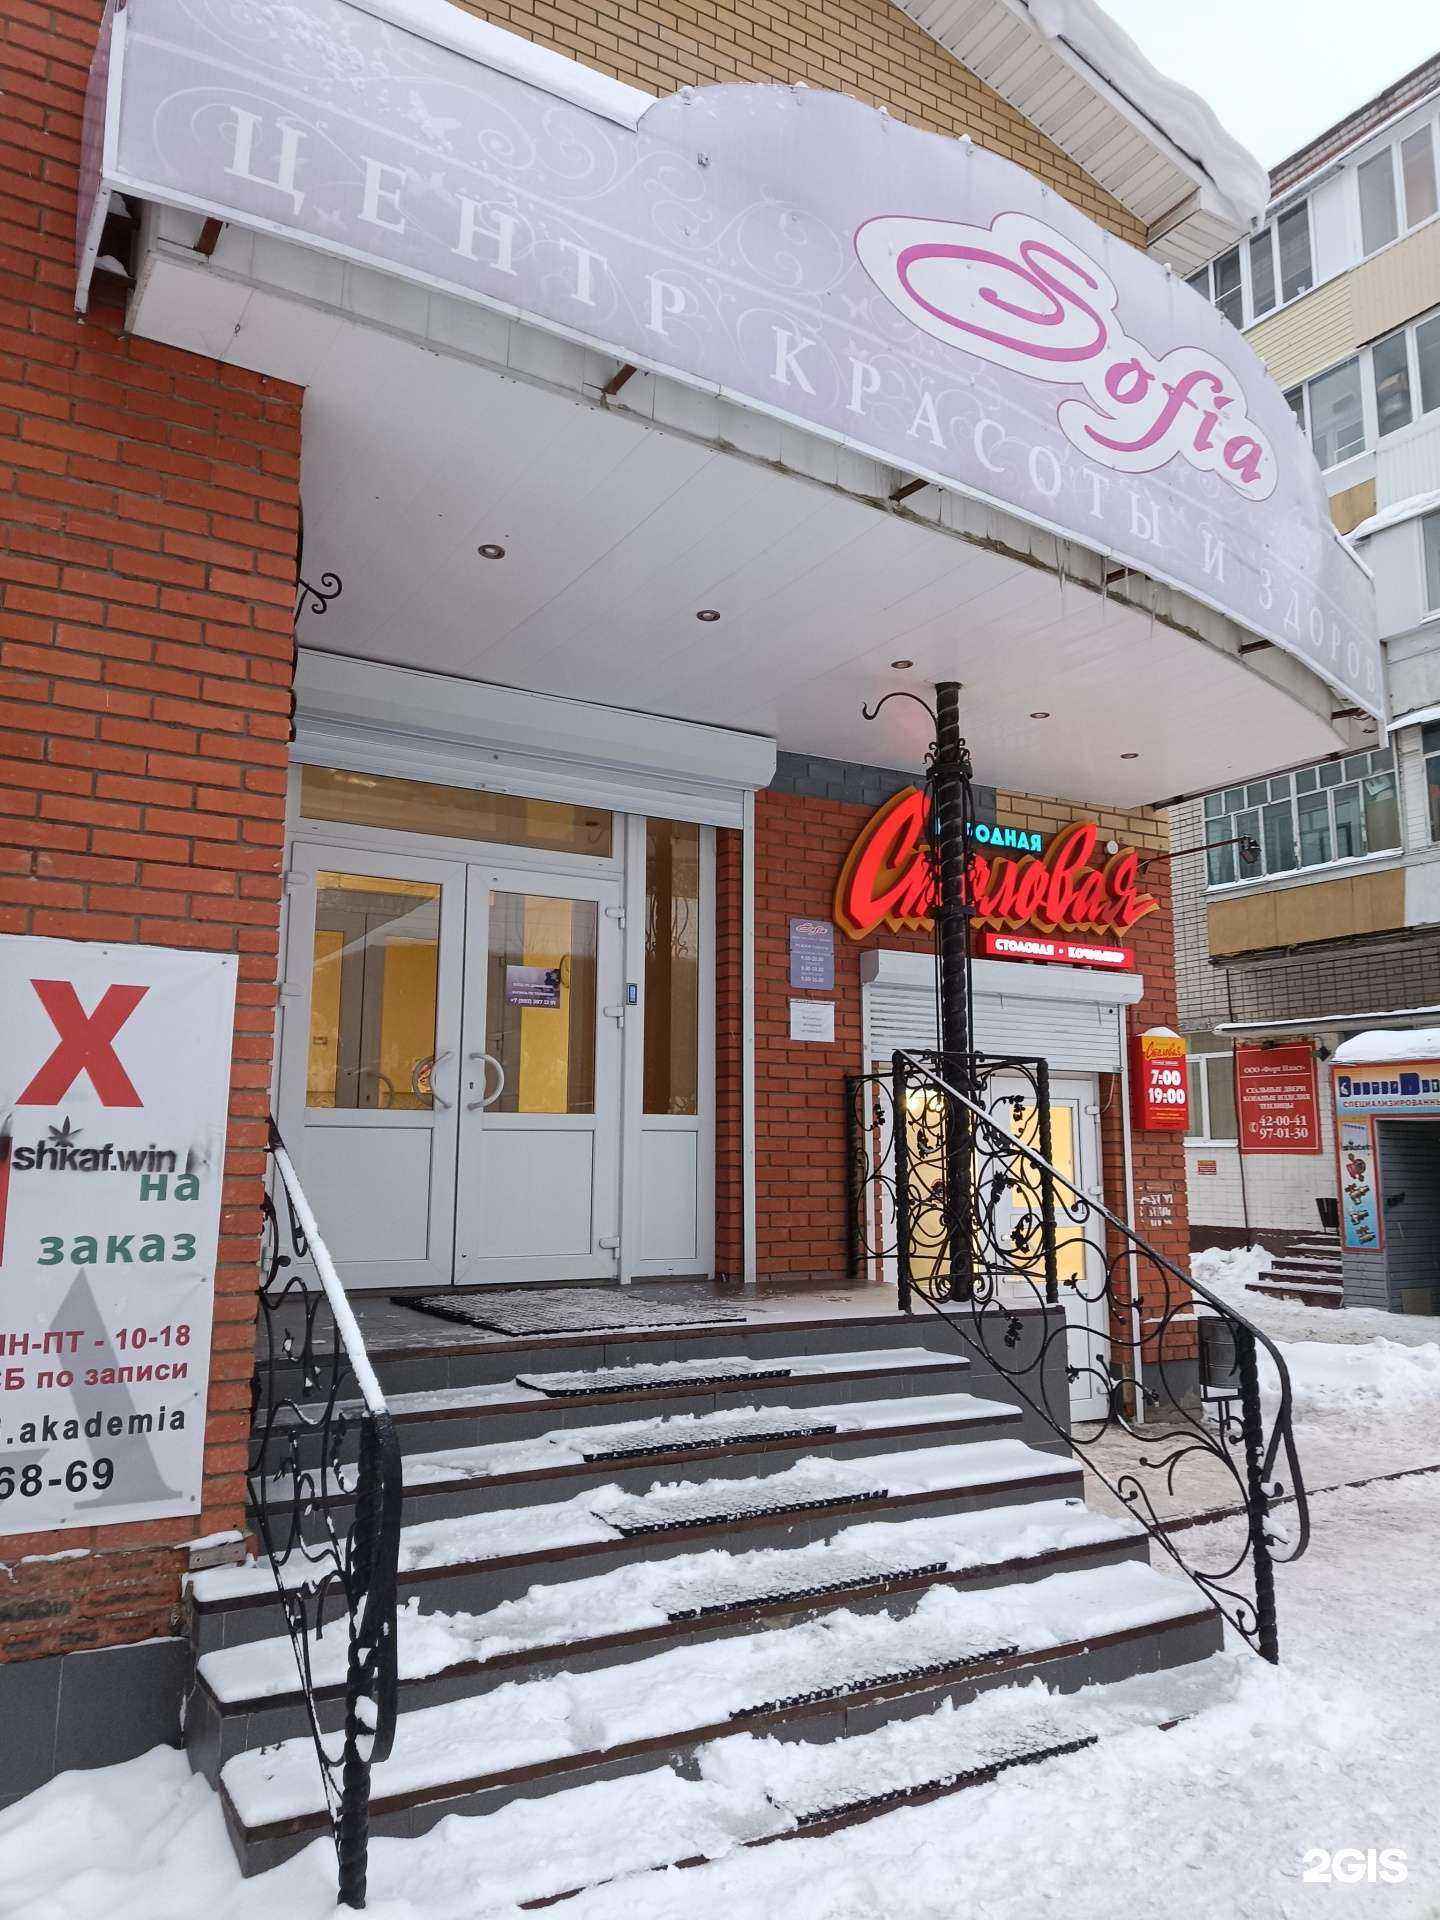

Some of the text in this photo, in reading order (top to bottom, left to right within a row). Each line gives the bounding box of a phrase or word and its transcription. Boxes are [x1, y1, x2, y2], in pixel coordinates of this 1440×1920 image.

[896, 239, 1266, 485] Sofia
[224, 105, 1377, 693] ЦЕНТР КРАСОТЫ И ЗДОРОВ
[1151, 1068, 1181, 1086] 7:00
[1148, 1087, 1185, 1105] 19:00
[1259, 1114, 1308, 1127] 42-00-41
[1259, 1127, 1309, 1140] 97-01-30
[12, 1140, 177, 1172] shkaf.win
[139, 1173, 200, 1201] на
[37, 1233, 196, 1266] заказ
[116, 1324, 190, 1350] 10-18
[0, 1362, 188, 1390] Б по записи
